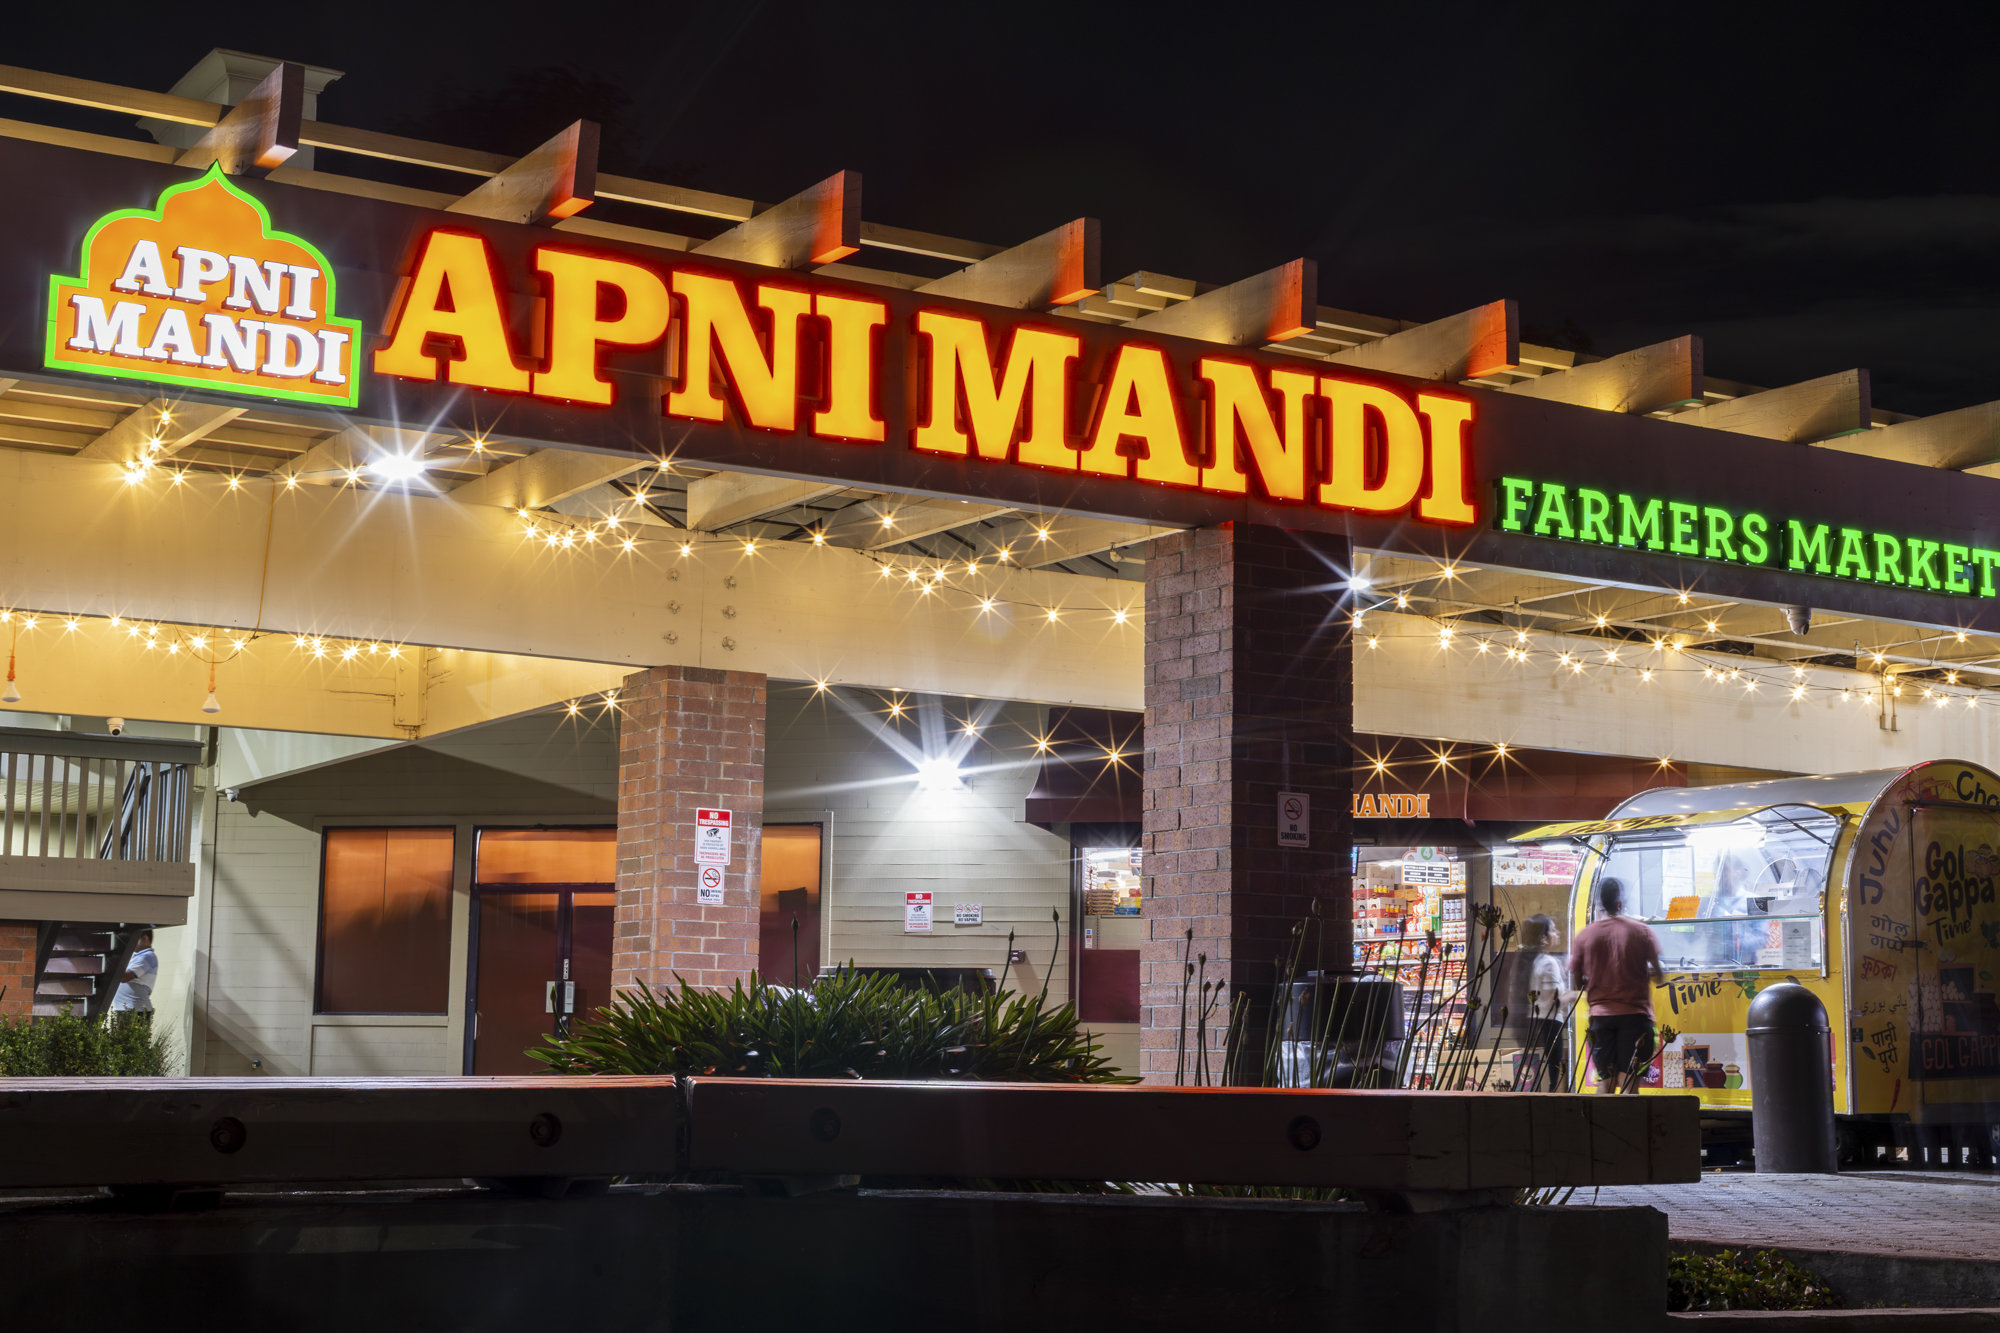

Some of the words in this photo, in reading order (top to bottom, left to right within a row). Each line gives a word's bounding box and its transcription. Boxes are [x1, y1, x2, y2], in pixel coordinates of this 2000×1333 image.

[115, 240, 320, 319] APNI
[66, 294, 350, 385] MANDI
[373, 231, 887, 442] APNI
[915, 310, 1476, 524] MANDI
[1502, 476, 1769, 564] FARMERS
[1788, 520, 2000, 597] MARKET
[1353, 793, 1431, 819] ANDI
[1280, 831, 1307, 842] SMOKING
[1289, 823, 1298, 833] NO
[1859, 807, 1902, 906] Juhu
[1956, 770, 2000, 812] Cho
[1423, 846, 1431, 858] 4
[1925, 840, 1965, 882] Gol
[701, 889, 710, 897] NO
[1915, 876, 1996, 924] Gappa
[1870, 914, 1910, 938] गोल
[1927, 917, 1972, 947] Time
[1861, 955, 1898, 982] ফুচকা
[1655, 975, 1724, 1015] Time
[1870, 1021, 1897, 1048] पानी
[1877, 1043, 1899, 1074] पुरी
[1921, 1038, 1955, 1070] GOL
